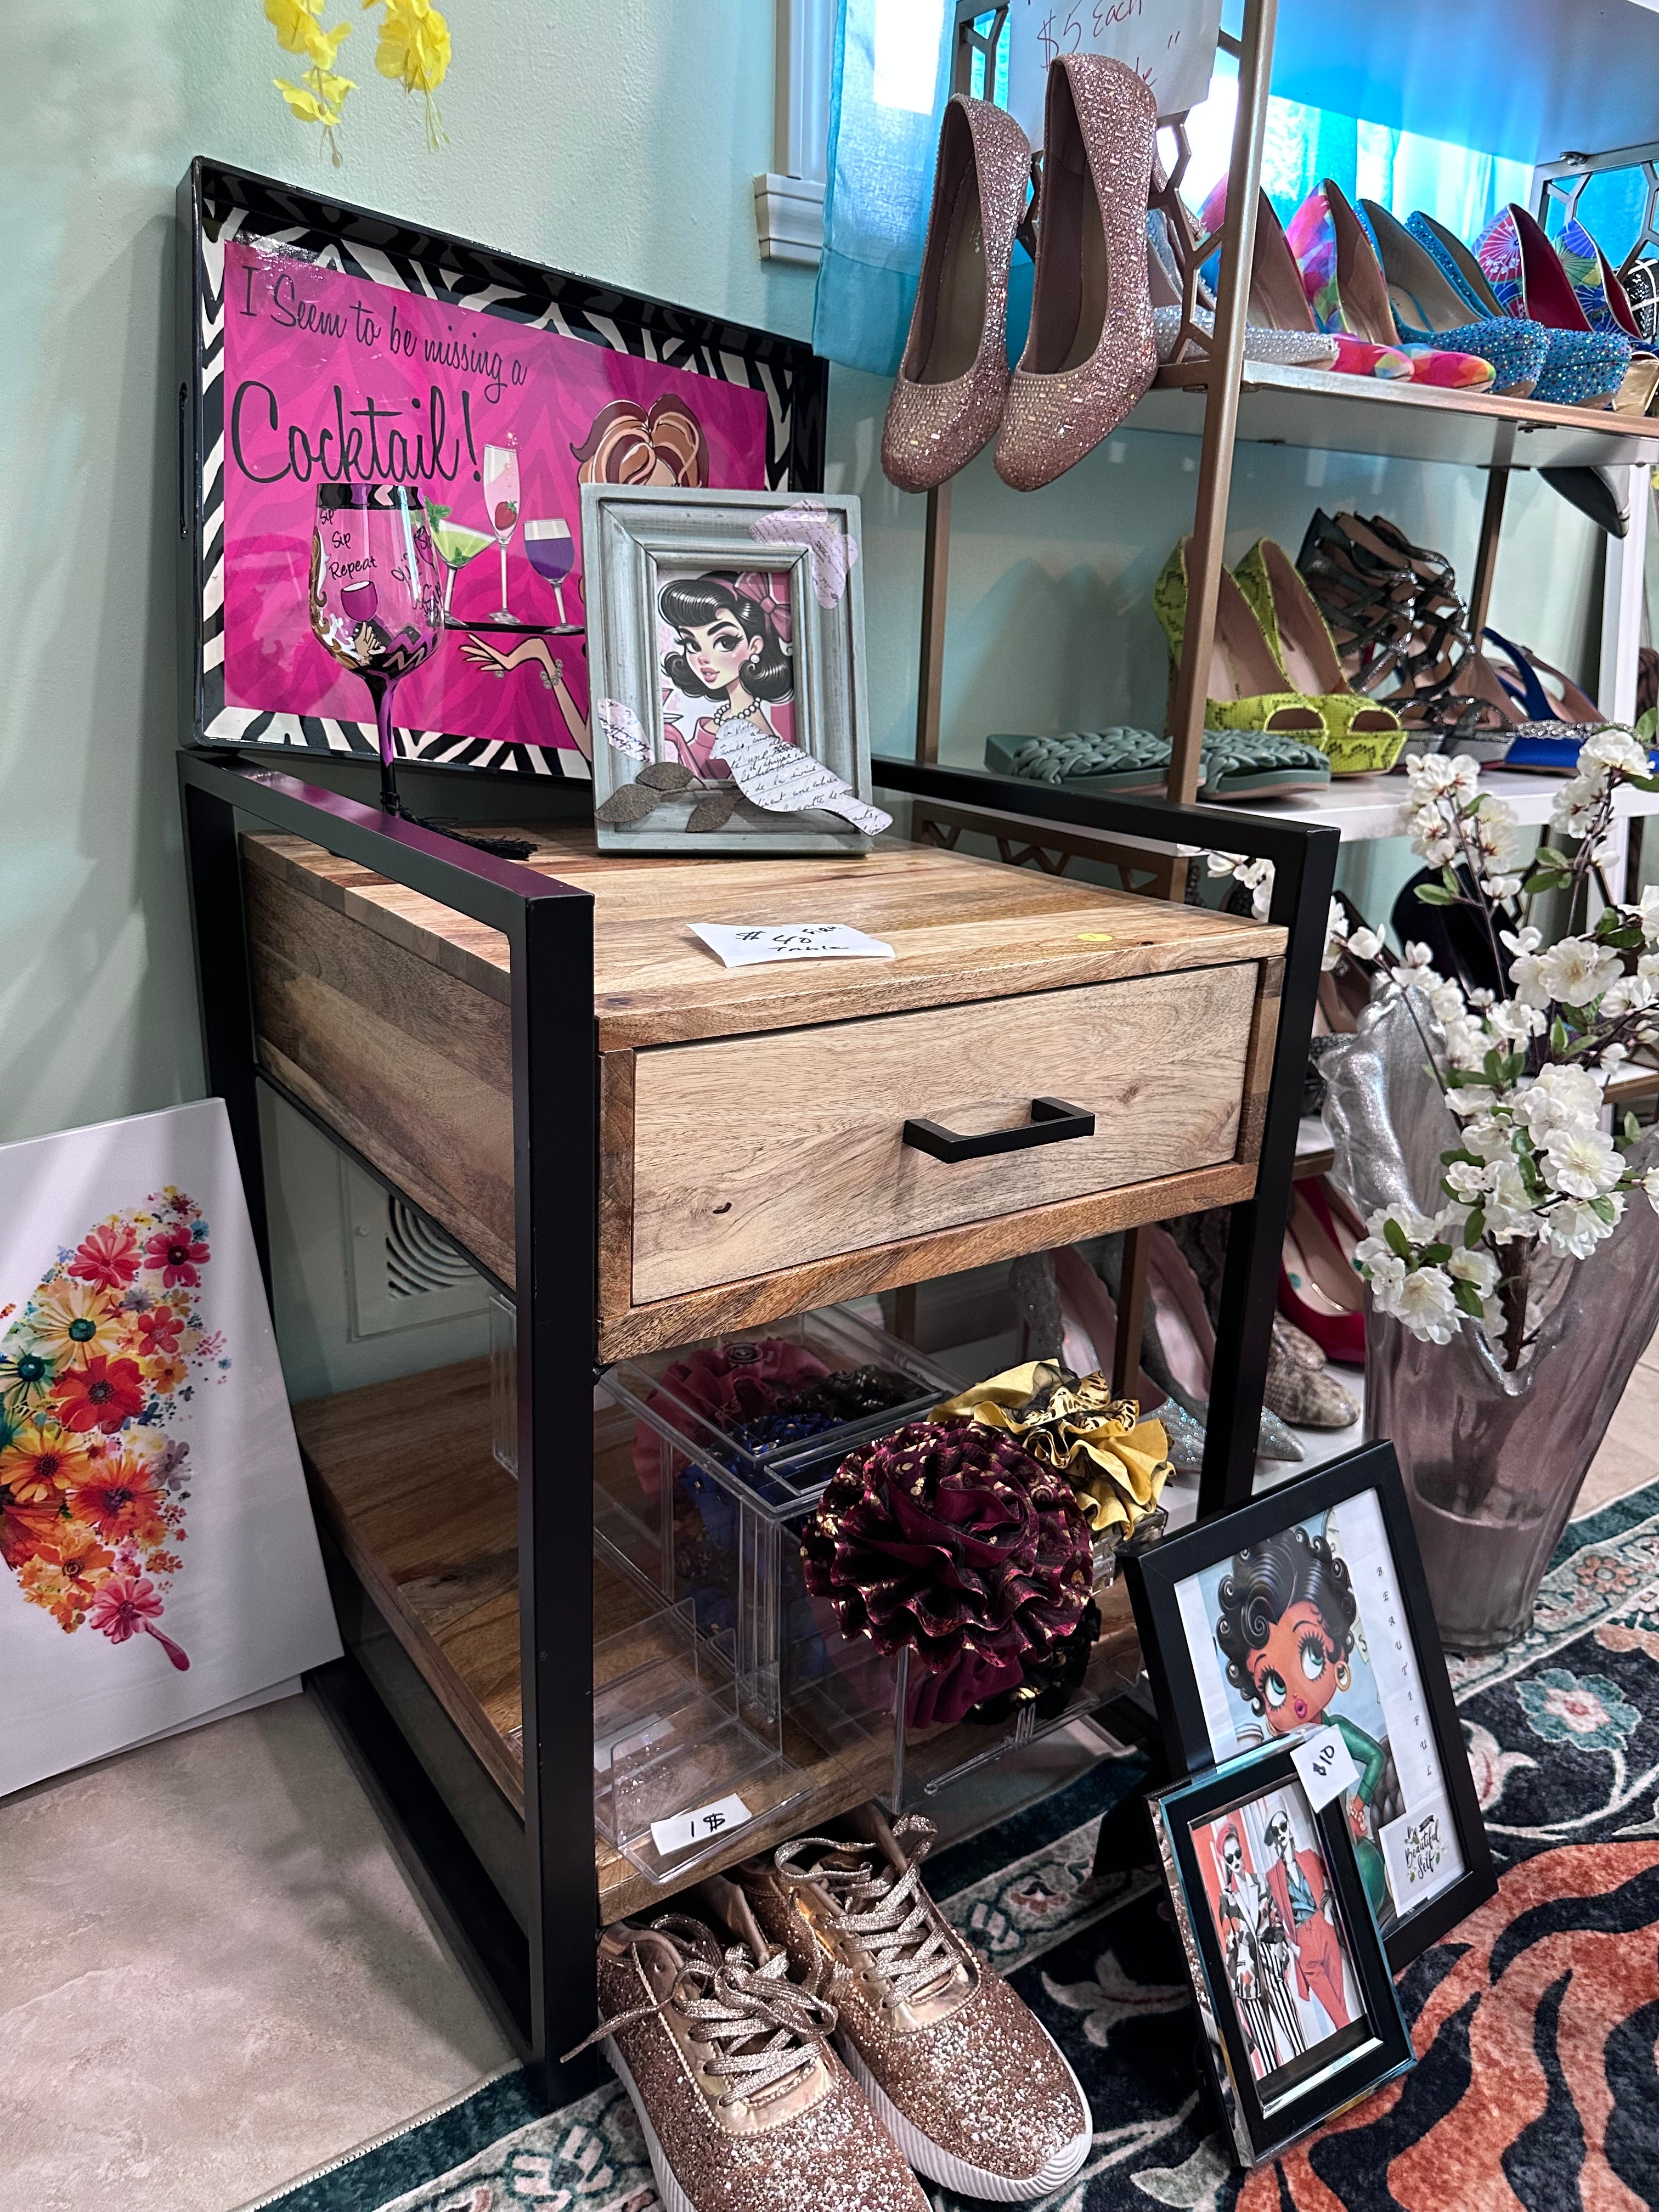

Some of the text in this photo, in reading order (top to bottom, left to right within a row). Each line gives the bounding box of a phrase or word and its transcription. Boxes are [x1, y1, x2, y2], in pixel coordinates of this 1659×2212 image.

[239, 266, 527, 404] I Seem to be missing a
[231, 380, 482, 483] Cocktail!
[332, 531, 351, 549] Sip
[329, 556, 377, 580] Repeat
[772, 935, 812, 945] 40
